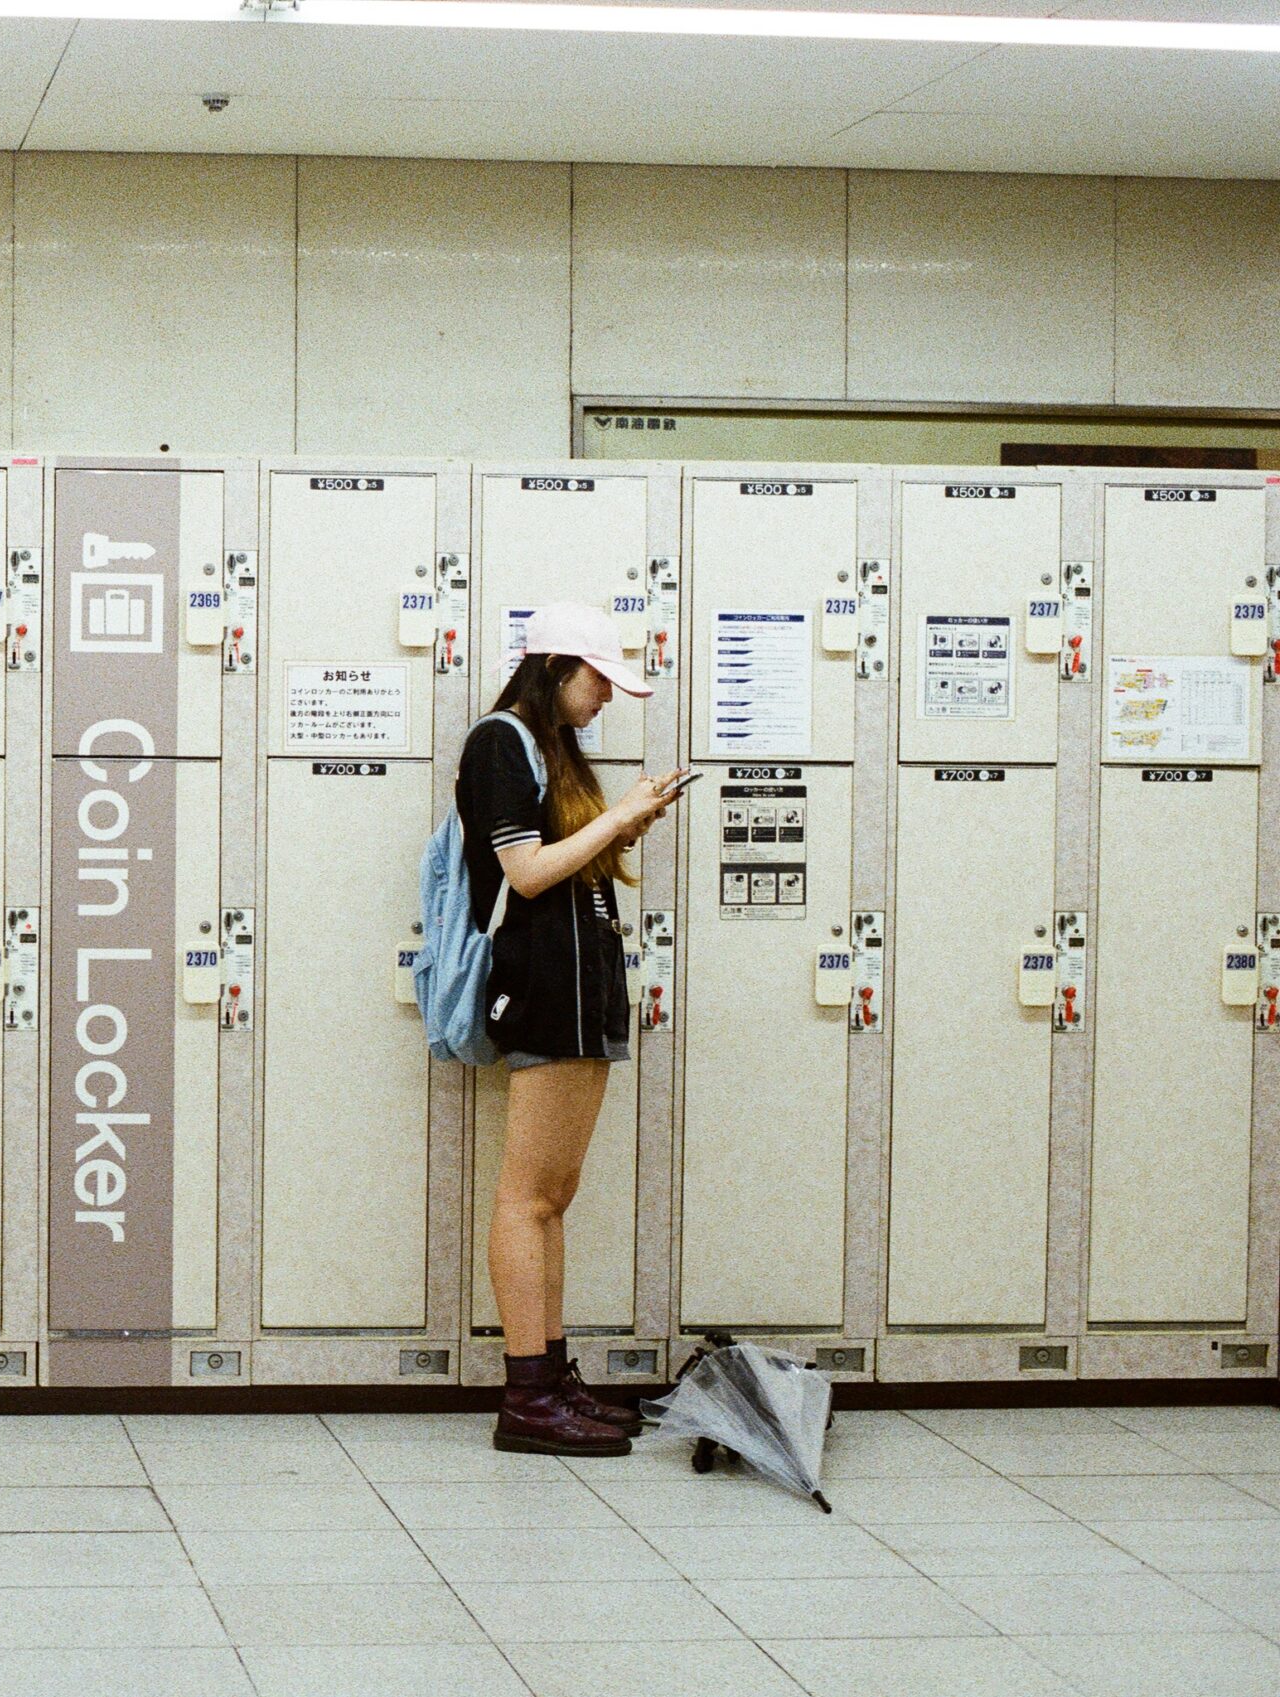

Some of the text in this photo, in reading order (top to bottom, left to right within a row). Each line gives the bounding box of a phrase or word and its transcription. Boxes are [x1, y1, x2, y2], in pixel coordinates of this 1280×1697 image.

[318, 478, 352, 489] ¥500
[528, 479, 563, 490] ¥500
[747, 484, 782, 494] ¥500
[952, 487, 985, 497] ¥500
[1152, 490, 1186, 501] ¥500
[190, 593, 220, 608] 2369
[403, 595, 432, 610] 2371
[614, 598, 644, 612] 2373
[826, 600, 855, 614] 2375
[1030, 602, 1059, 616] 2377
[1234, 605, 1264, 619] 2379
[323, 670, 371, 682] お知らせ
[320, 764, 355, 774] ¥700
[736, 768, 770, 778] ¥700
[941, 770, 974, 780] ¥700
[1149, 771, 1183, 781] ¥700
[186, 951, 216, 966] 2370
[820, 954, 850, 968] 2376
[1023, 955, 1053, 970] 2378
[1226, 955, 1256, 969] 2380
[74, 719, 156, 1242] Coin Locker
